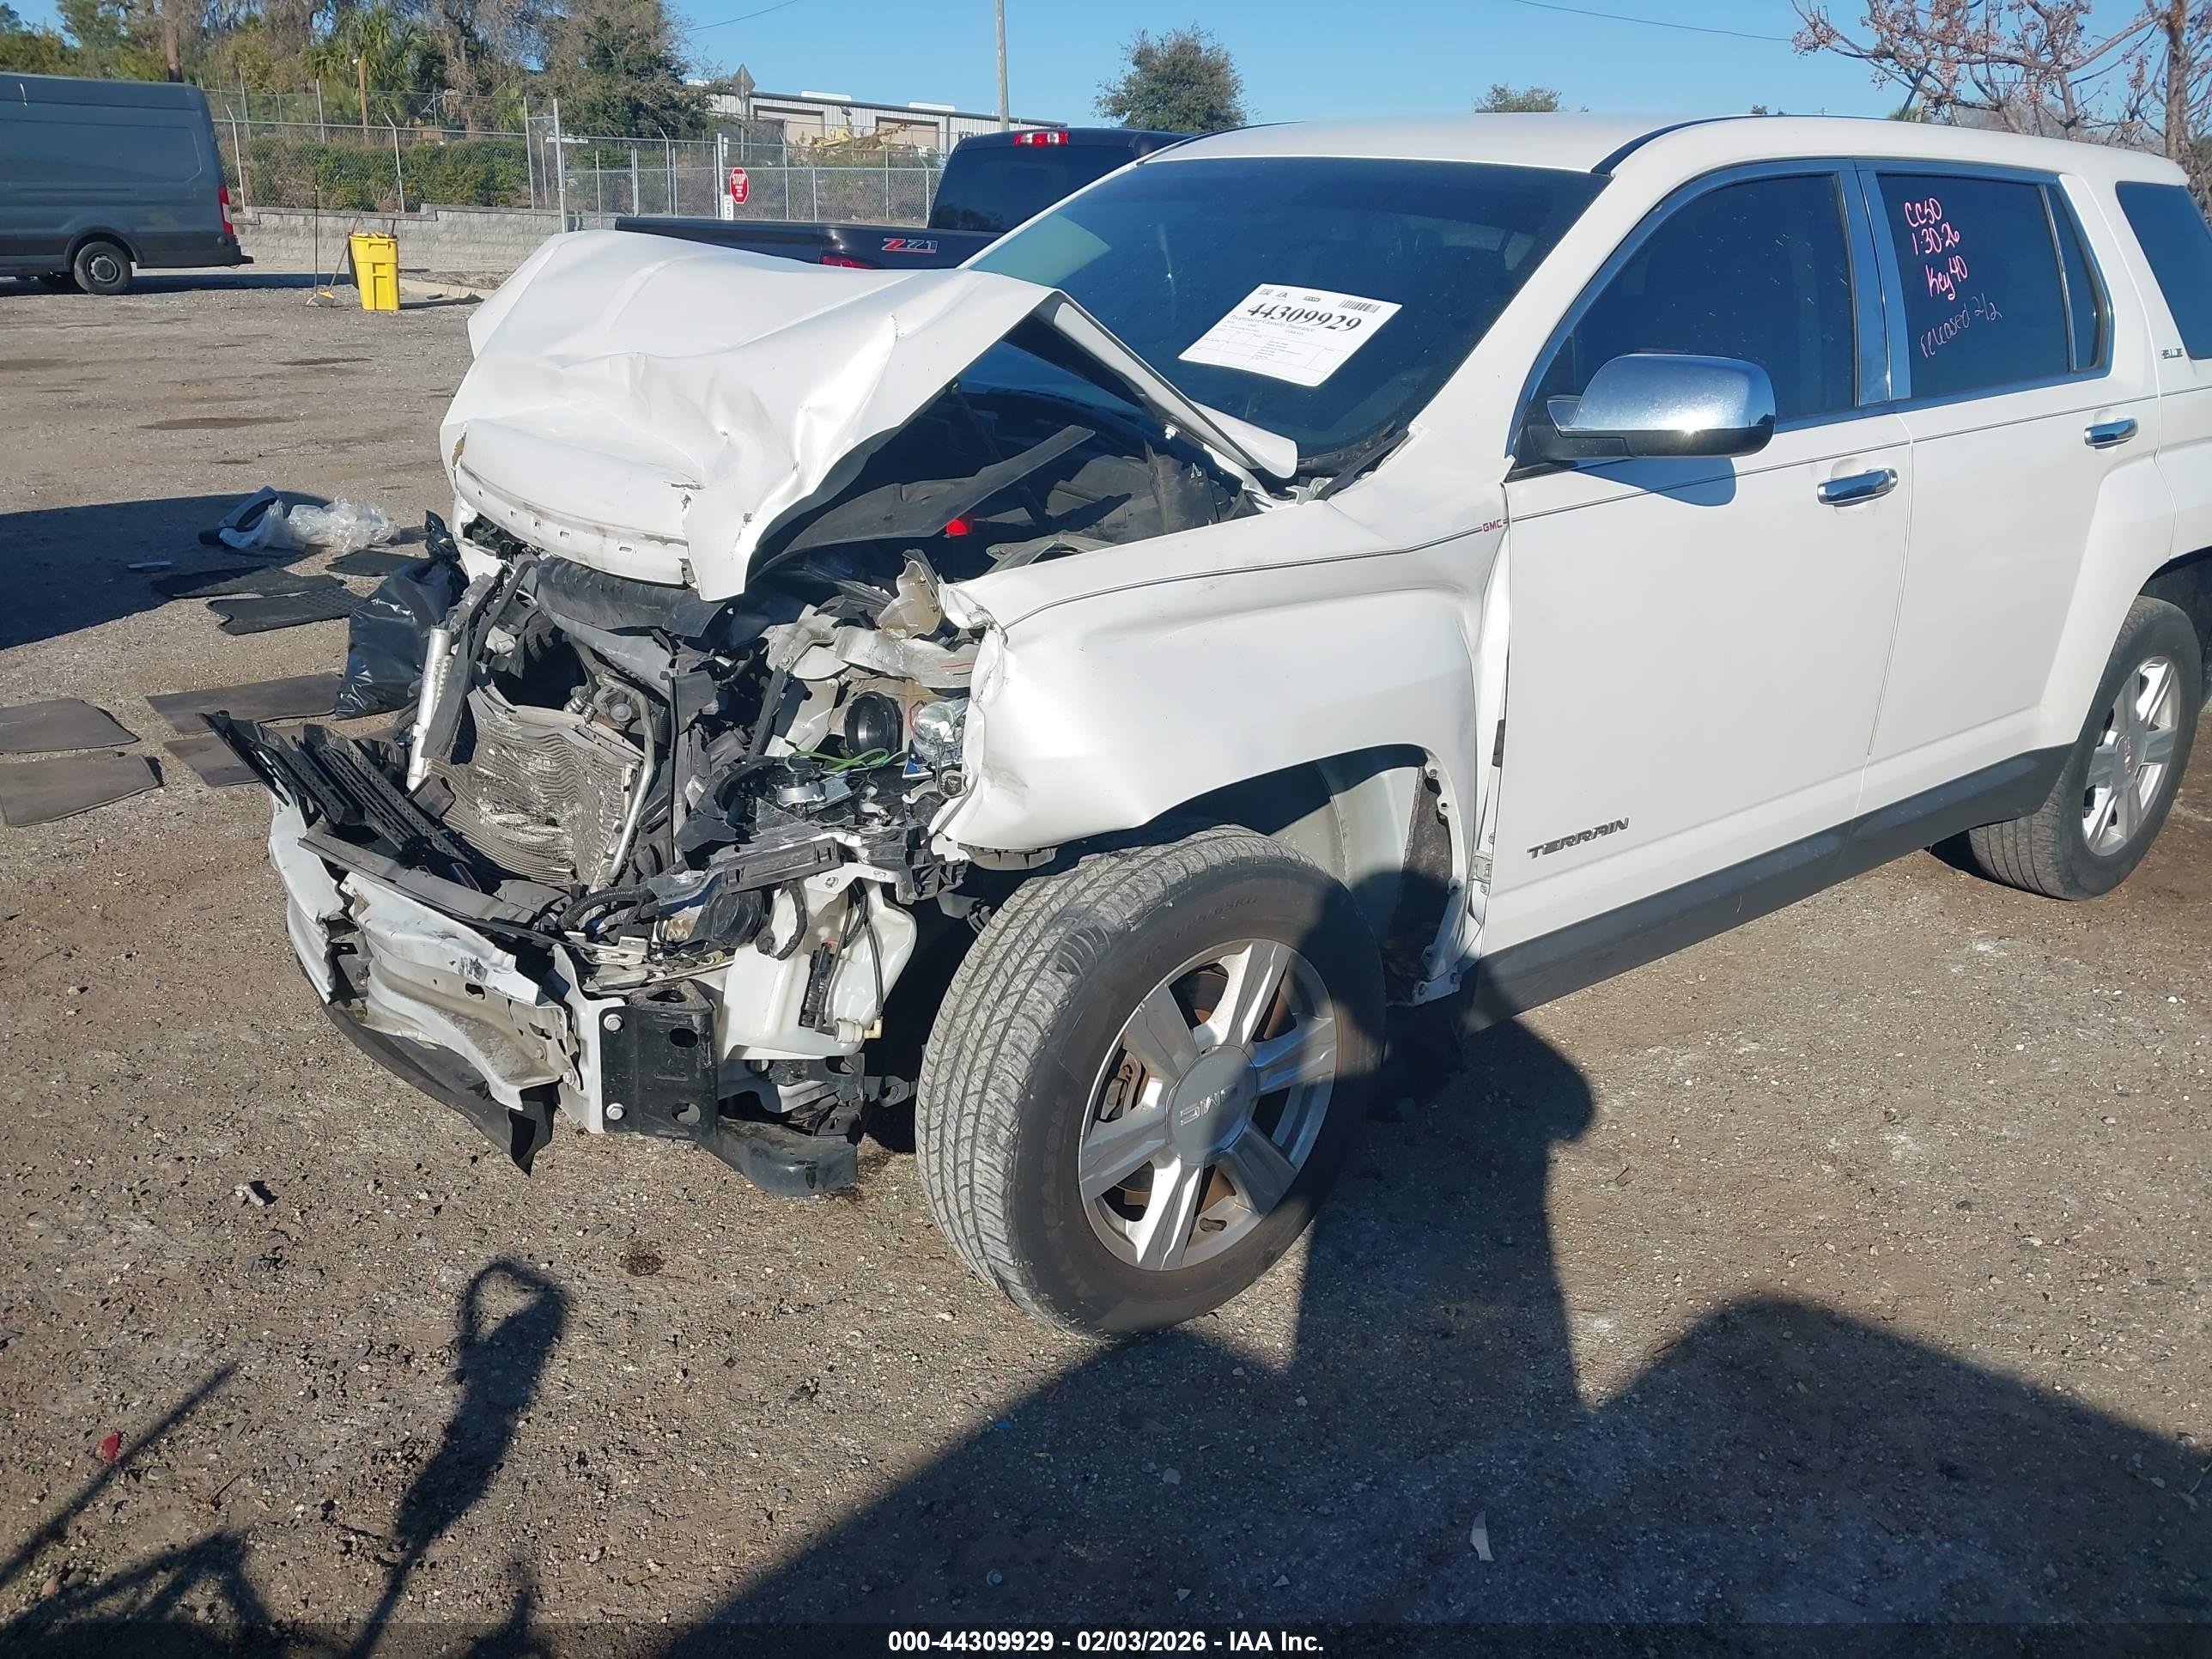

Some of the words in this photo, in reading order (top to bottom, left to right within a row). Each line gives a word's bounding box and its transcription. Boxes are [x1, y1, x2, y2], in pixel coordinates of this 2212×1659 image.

[732, 173, 745, 185] STOP
[881, 237, 939, 254] Z71
[1948, 255, 1968, 283] 40
[1247, 302, 1362, 332] 44309929
[1482, 519, 1503, 532] GMC
[1527, 817, 1630, 859] TERRAIN
